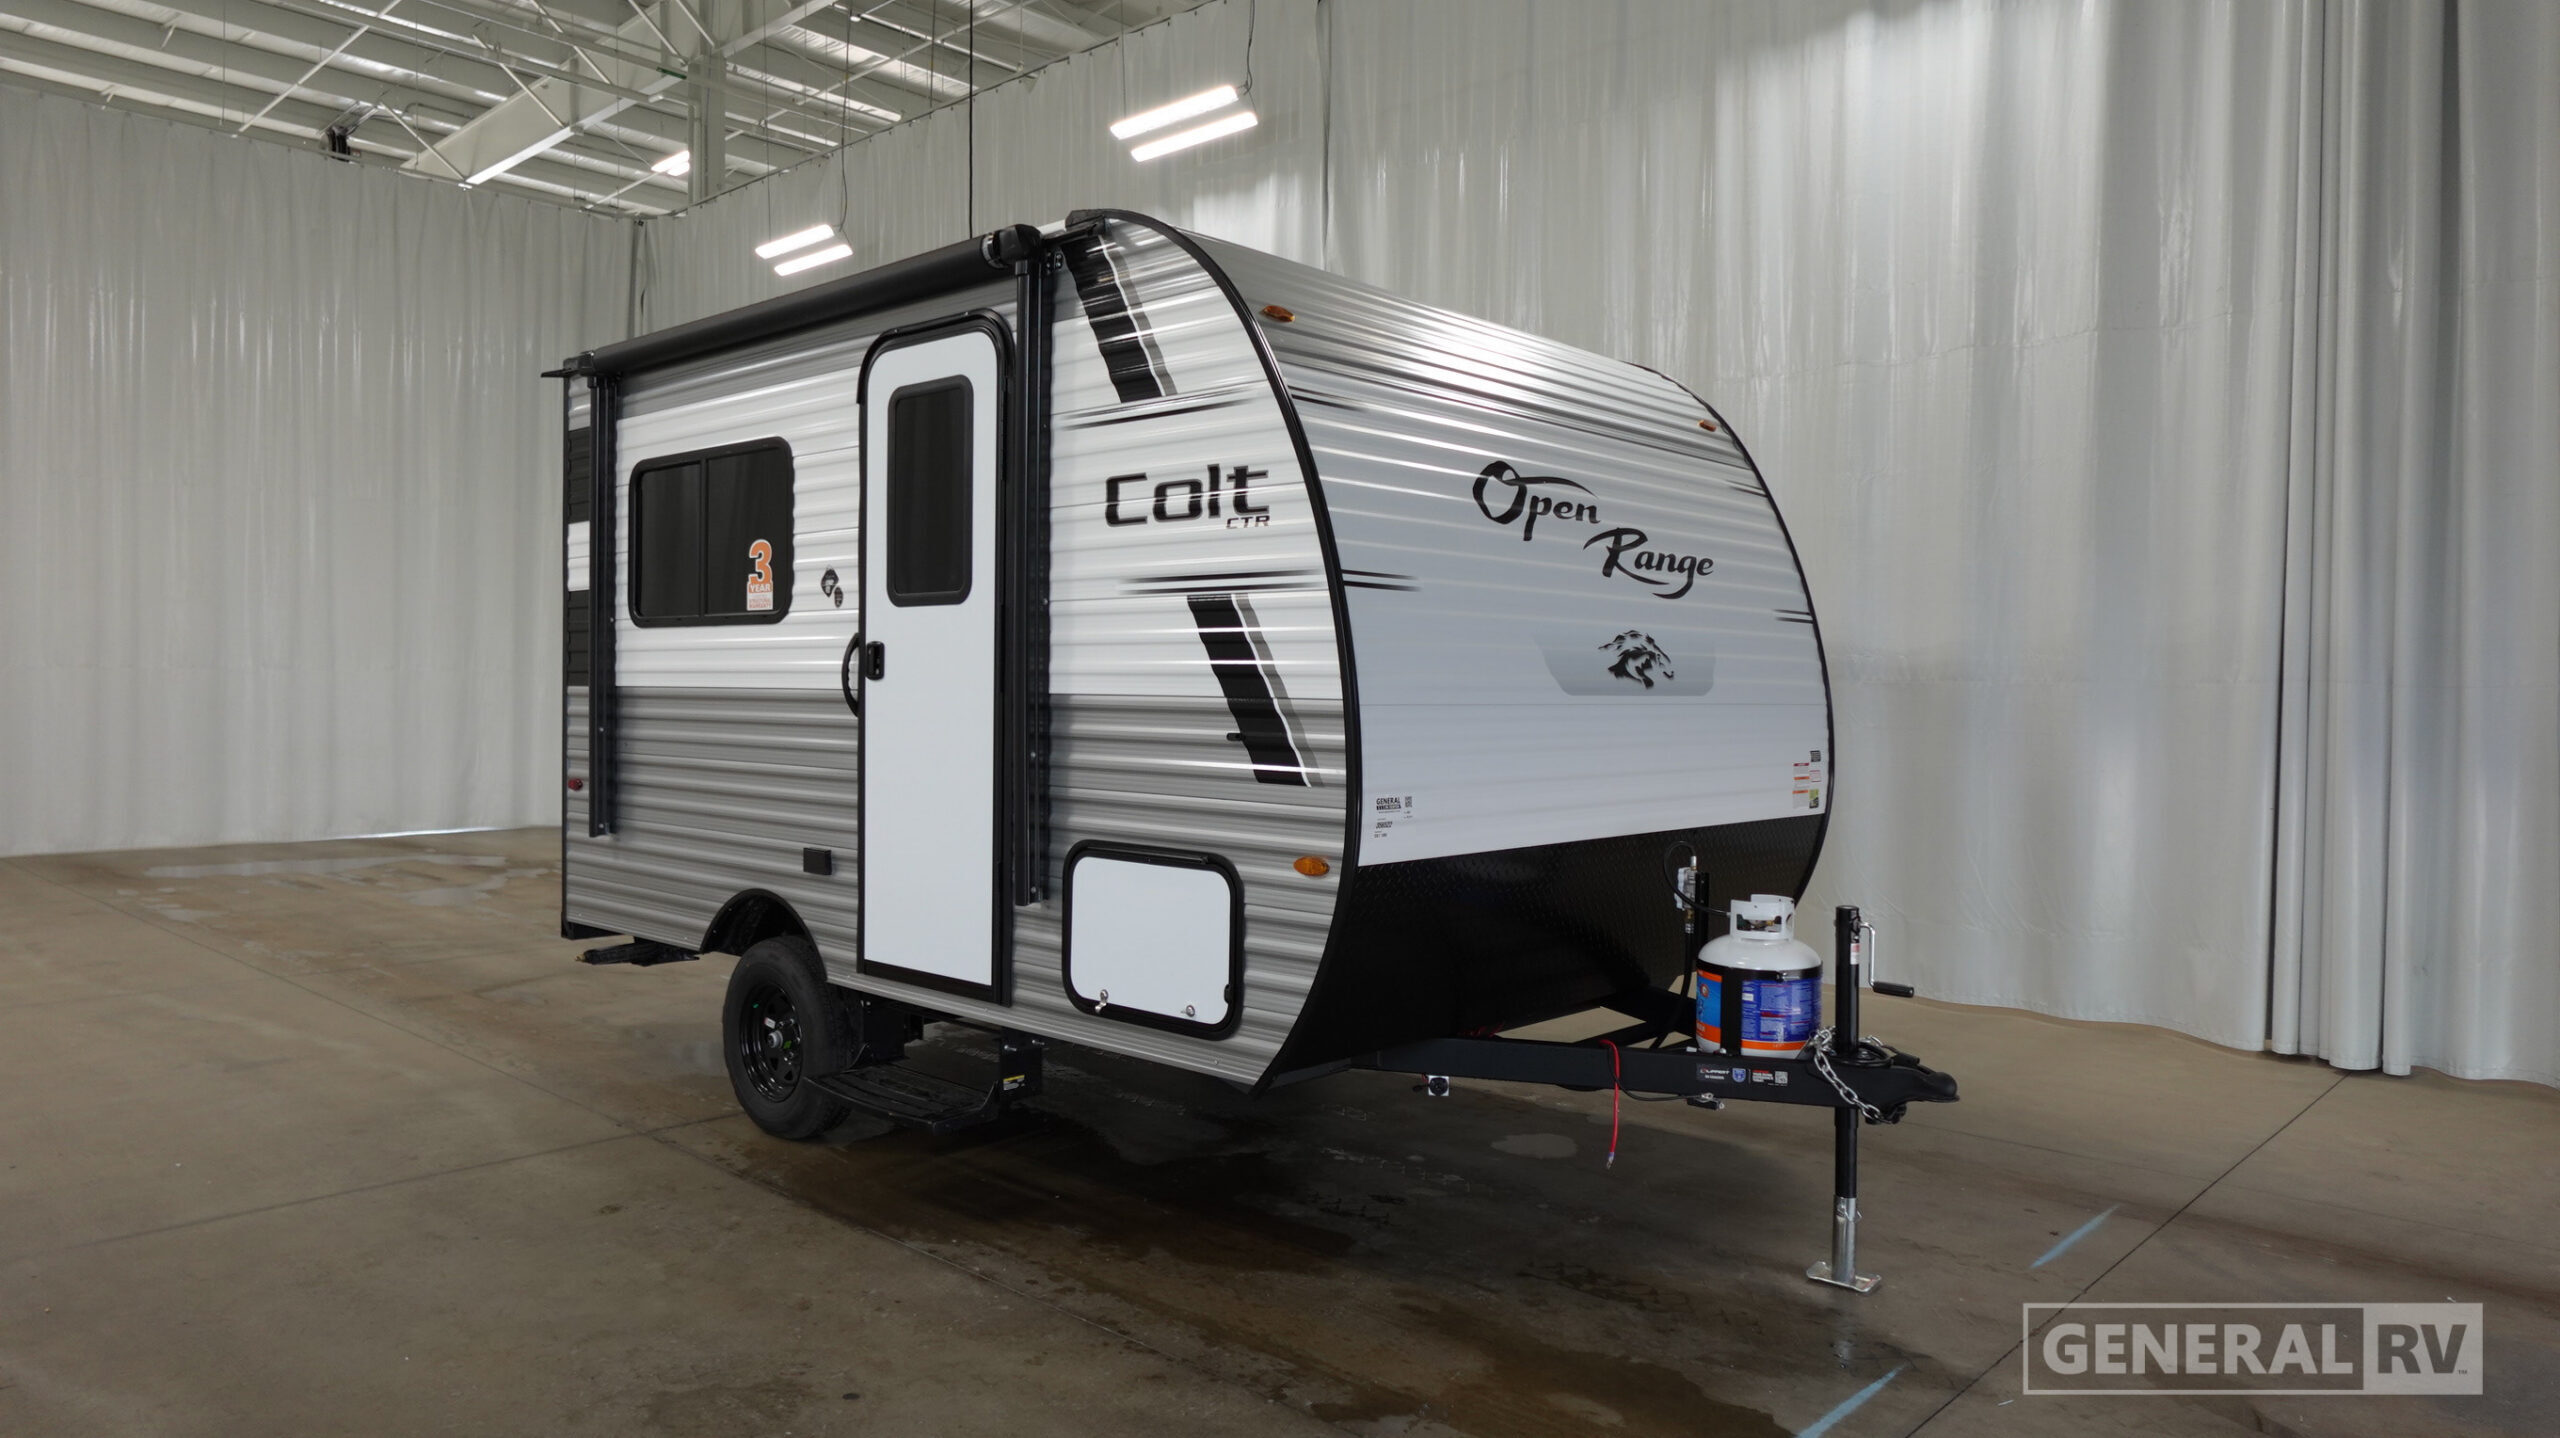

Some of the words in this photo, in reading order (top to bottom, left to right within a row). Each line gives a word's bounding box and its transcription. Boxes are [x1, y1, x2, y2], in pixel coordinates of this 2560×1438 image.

[1105, 463, 1269, 527] Colt
[1473, 461, 1601, 541] Open
[1226, 515, 1271, 529] CTR
[749, 539, 773, 584] 3
[1583, 527, 1714, 599] Range
[750, 583, 771, 593] YEAR
[1376, 797, 1401, 805] GENERAL
